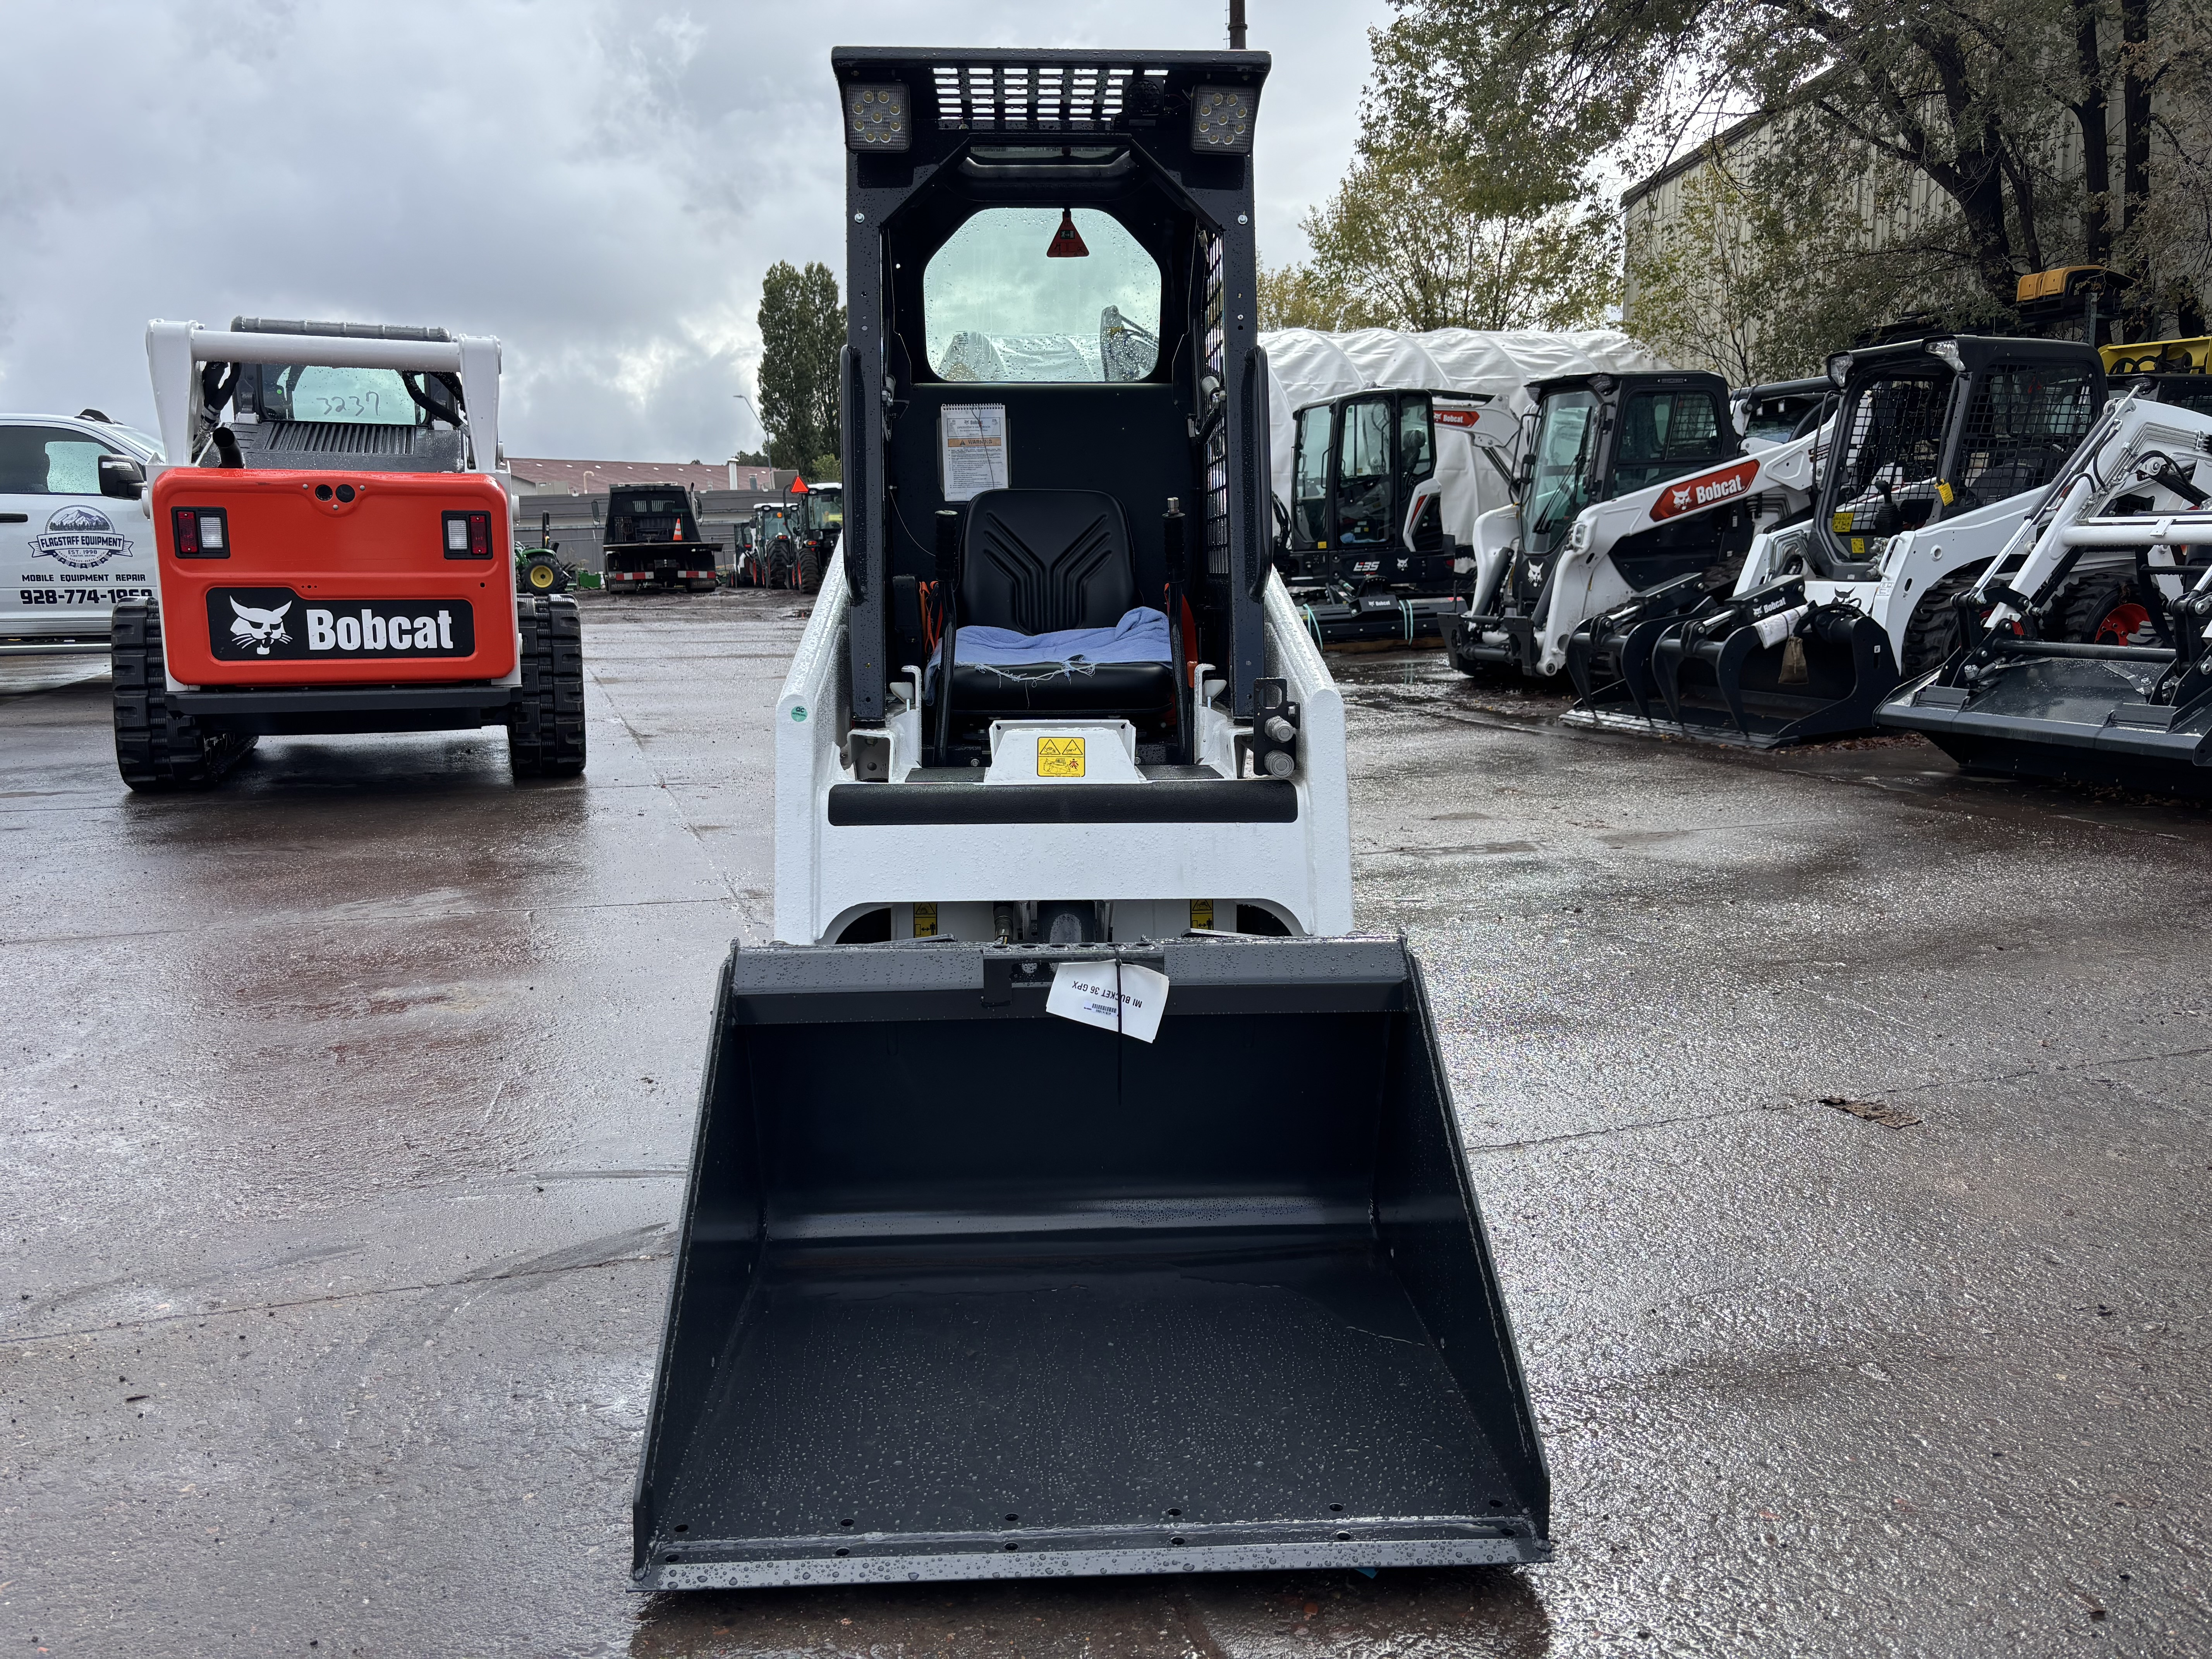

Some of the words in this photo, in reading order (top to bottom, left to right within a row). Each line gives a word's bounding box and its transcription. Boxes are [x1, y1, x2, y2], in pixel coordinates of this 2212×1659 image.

[316, 390, 379, 416] 3237
[1443, 414, 1463, 423] Bobcat
[1696, 474, 1742, 504] Bobcat
[40, 536, 79, 548] FLAGSTAFF
[81, 536, 122, 547] EQUIPMENT
[1353, 561, 1380, 571] E35
[1763, 597, 1786, 613] Bobcat
[306, 609, 453, 650] Bobcat
[1072, 981, 1088, 991] GPX
[1090, 986, 1100, 995] 36
[1132, 998, 1142, 1008] MI
